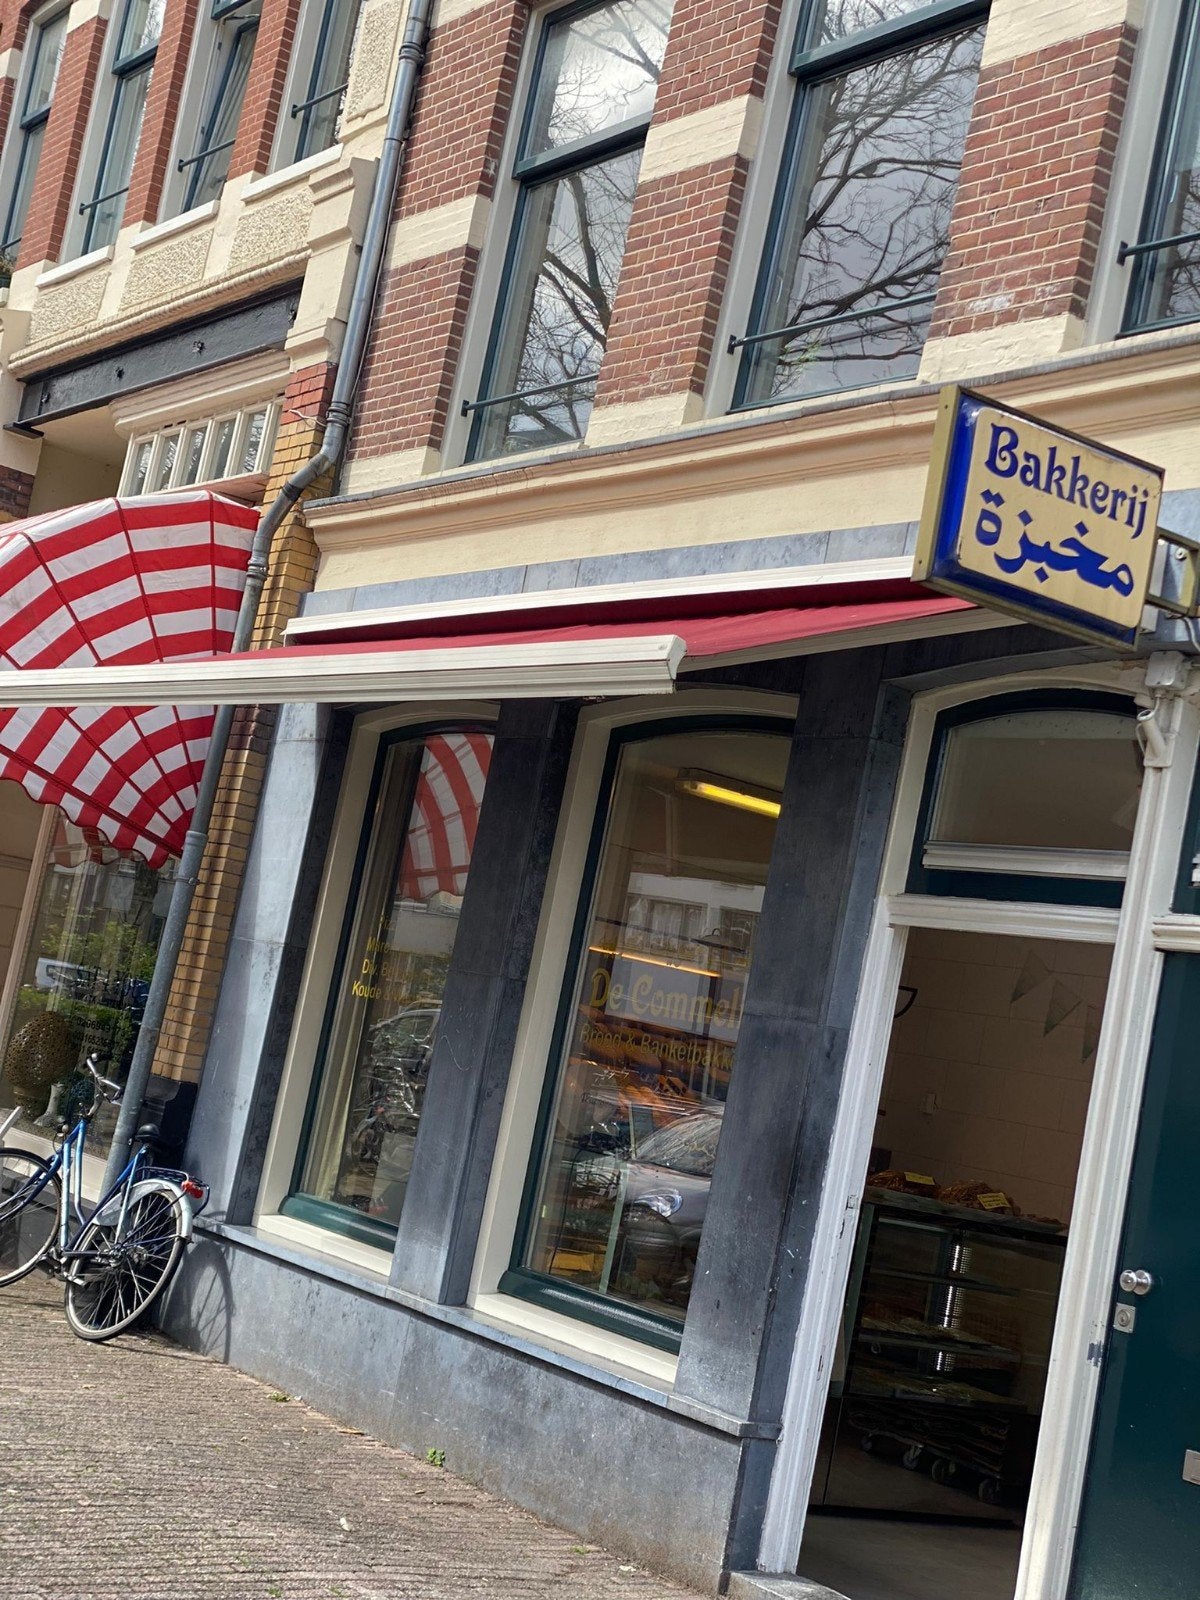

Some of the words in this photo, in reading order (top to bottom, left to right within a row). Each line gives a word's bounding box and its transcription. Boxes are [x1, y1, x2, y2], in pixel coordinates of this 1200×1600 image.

[984, 423, 1149, 539] Bakkerij
[975, 489, 1134, 597] مخبزة
[590, 968, 624, 1011] De
